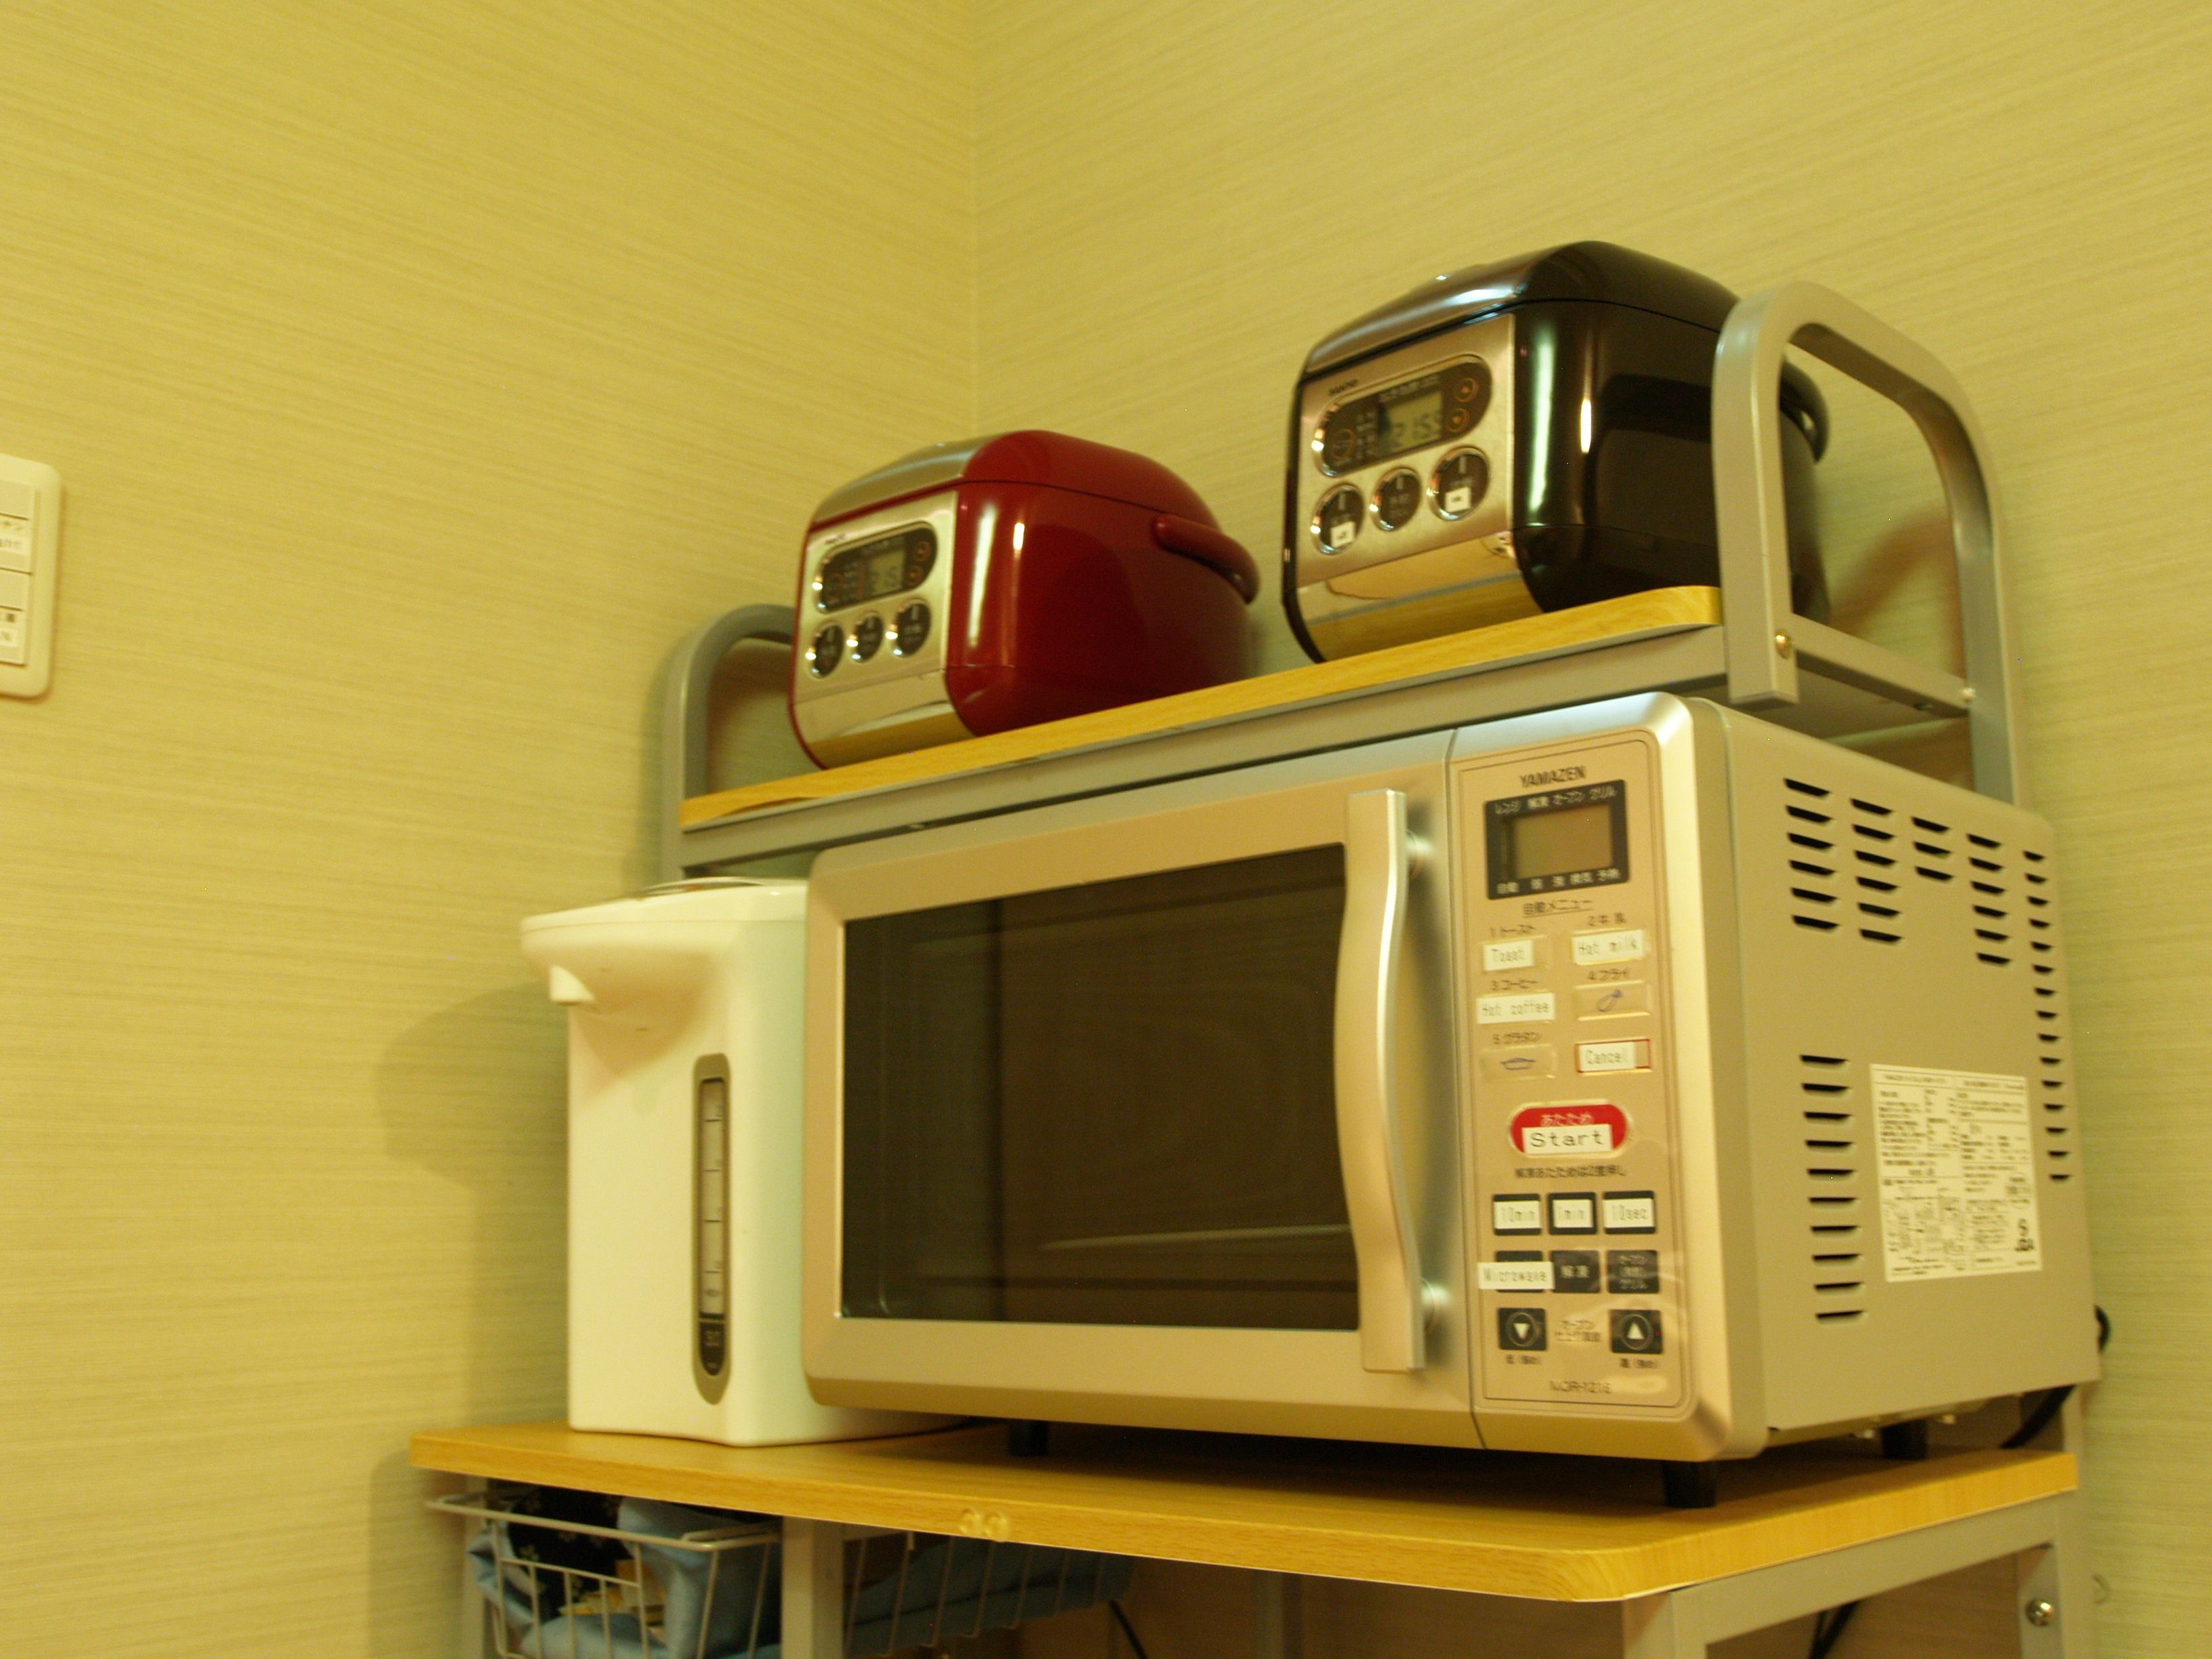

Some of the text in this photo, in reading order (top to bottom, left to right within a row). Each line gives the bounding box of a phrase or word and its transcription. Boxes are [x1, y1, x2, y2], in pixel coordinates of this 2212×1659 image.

[1519, 764, 1586, 788] YAMAZEN
[1578, 939, 1600, 955] Hot
[1491, 948, 1525, 963] Toast
[1481, 1002, 1502, 1017] Hot
[1586, 1048, 1627, 1065] Cancel
[1530, 1130, 1604, 1148] Start
